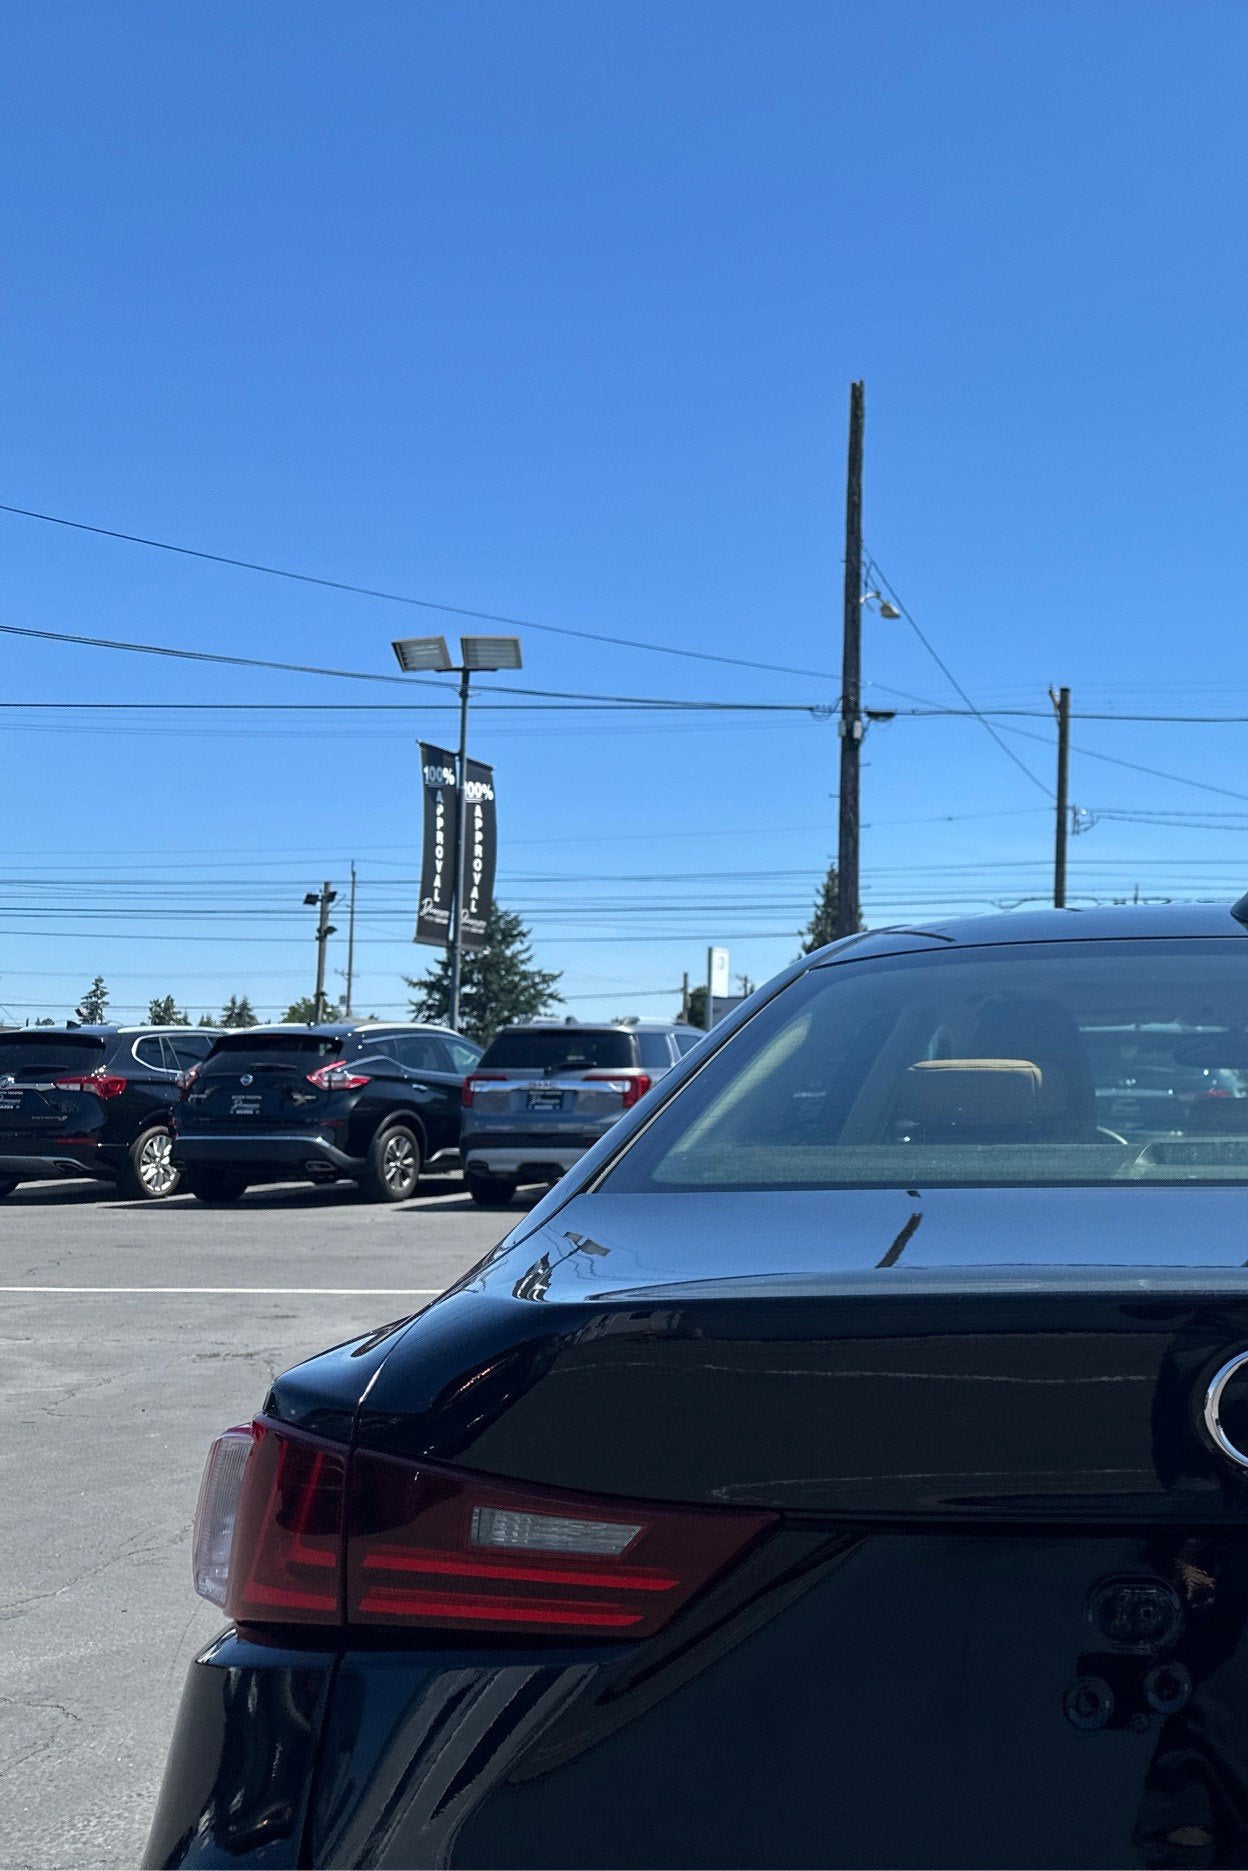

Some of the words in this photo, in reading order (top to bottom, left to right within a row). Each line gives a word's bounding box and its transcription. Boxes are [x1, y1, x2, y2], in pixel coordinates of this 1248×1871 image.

[423, 765, 455, 785] 100%
[433, 789, 444, 902] APPROVAL
[470, 804, 483, 913] APPROVAL
